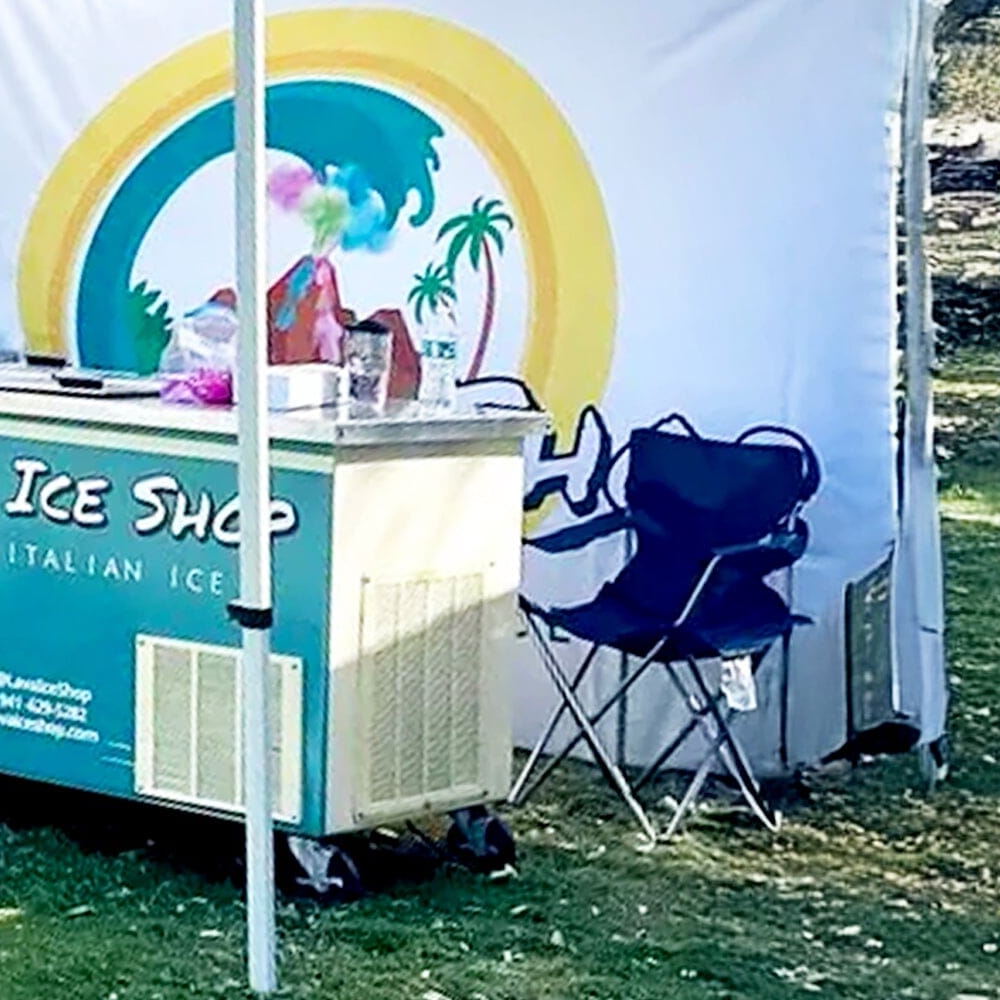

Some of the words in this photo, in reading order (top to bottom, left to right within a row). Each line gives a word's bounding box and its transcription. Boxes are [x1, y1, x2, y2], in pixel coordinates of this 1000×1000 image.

[4, 457, 110, 526] ICE
[7, 542, 143, 582] ITALIAN
[169, 565, 224, 596] ICE
